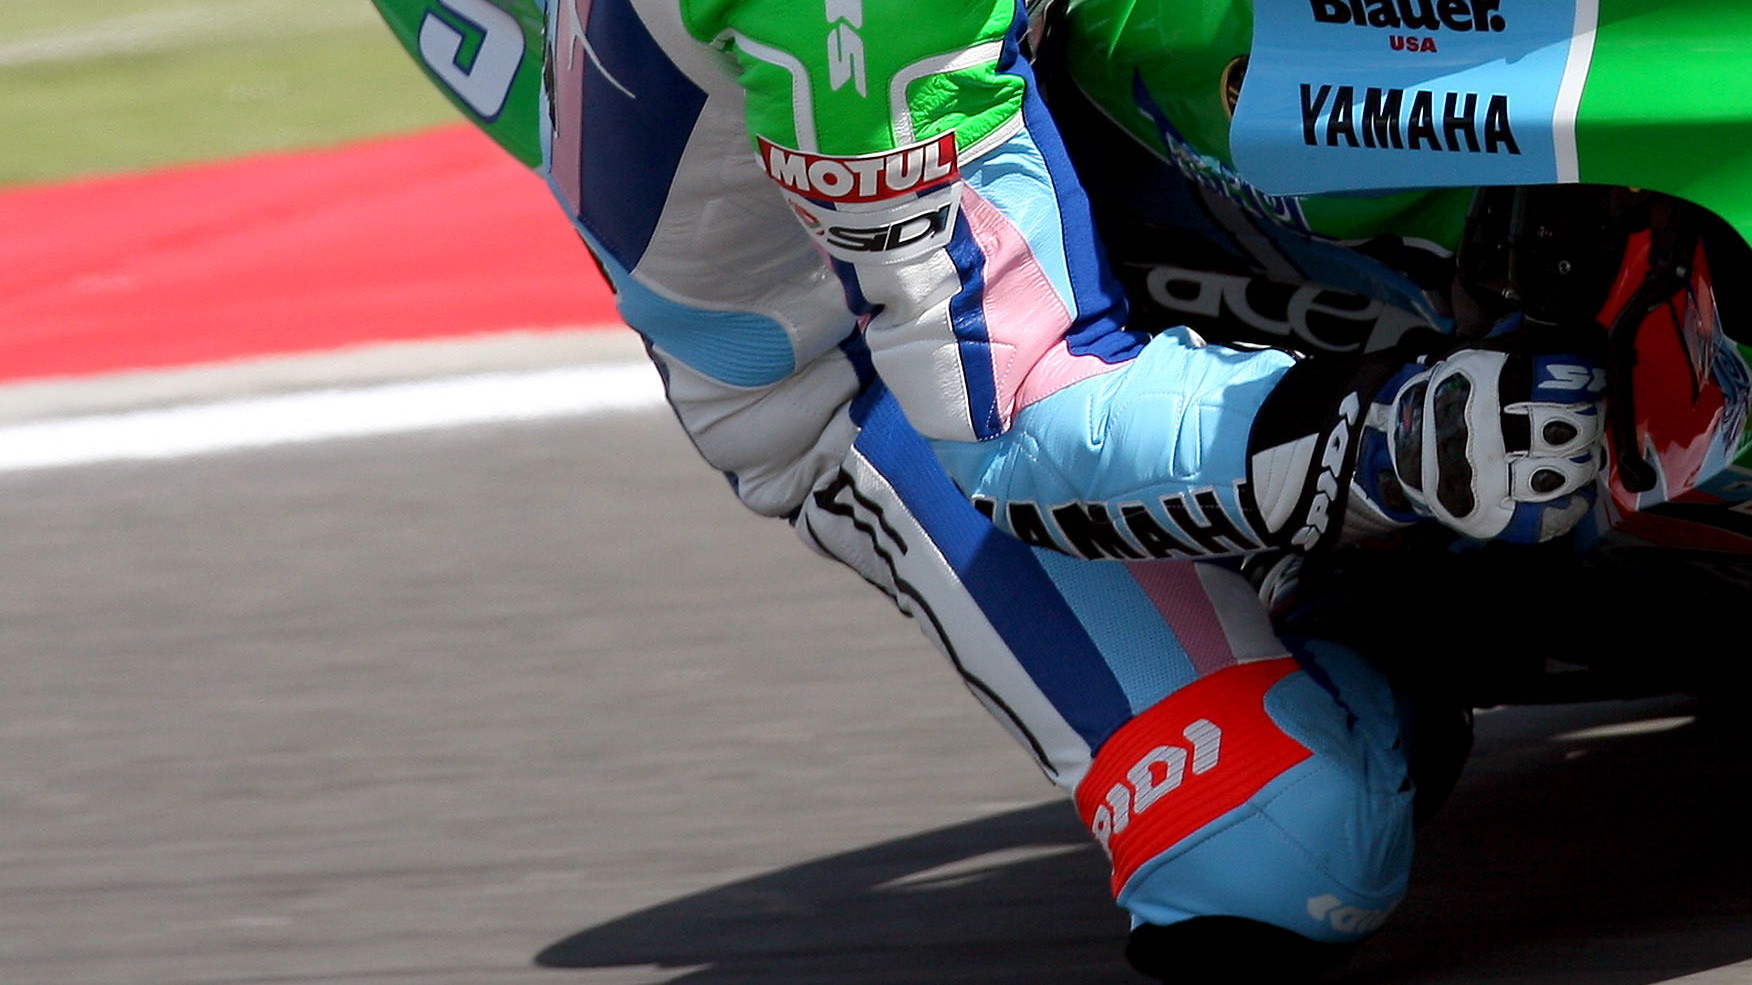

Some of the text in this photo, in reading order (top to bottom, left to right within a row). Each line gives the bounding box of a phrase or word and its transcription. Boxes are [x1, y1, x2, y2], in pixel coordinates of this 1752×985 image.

[1389, 35, 1438, 54] USA
[1299, 83, 1522, 156] YAMAHA
[770, 142, 952, 198] MOTUL
[972, 487, 1262, 561] AMAH
[1092, 718, 1222, 862] PIDI
